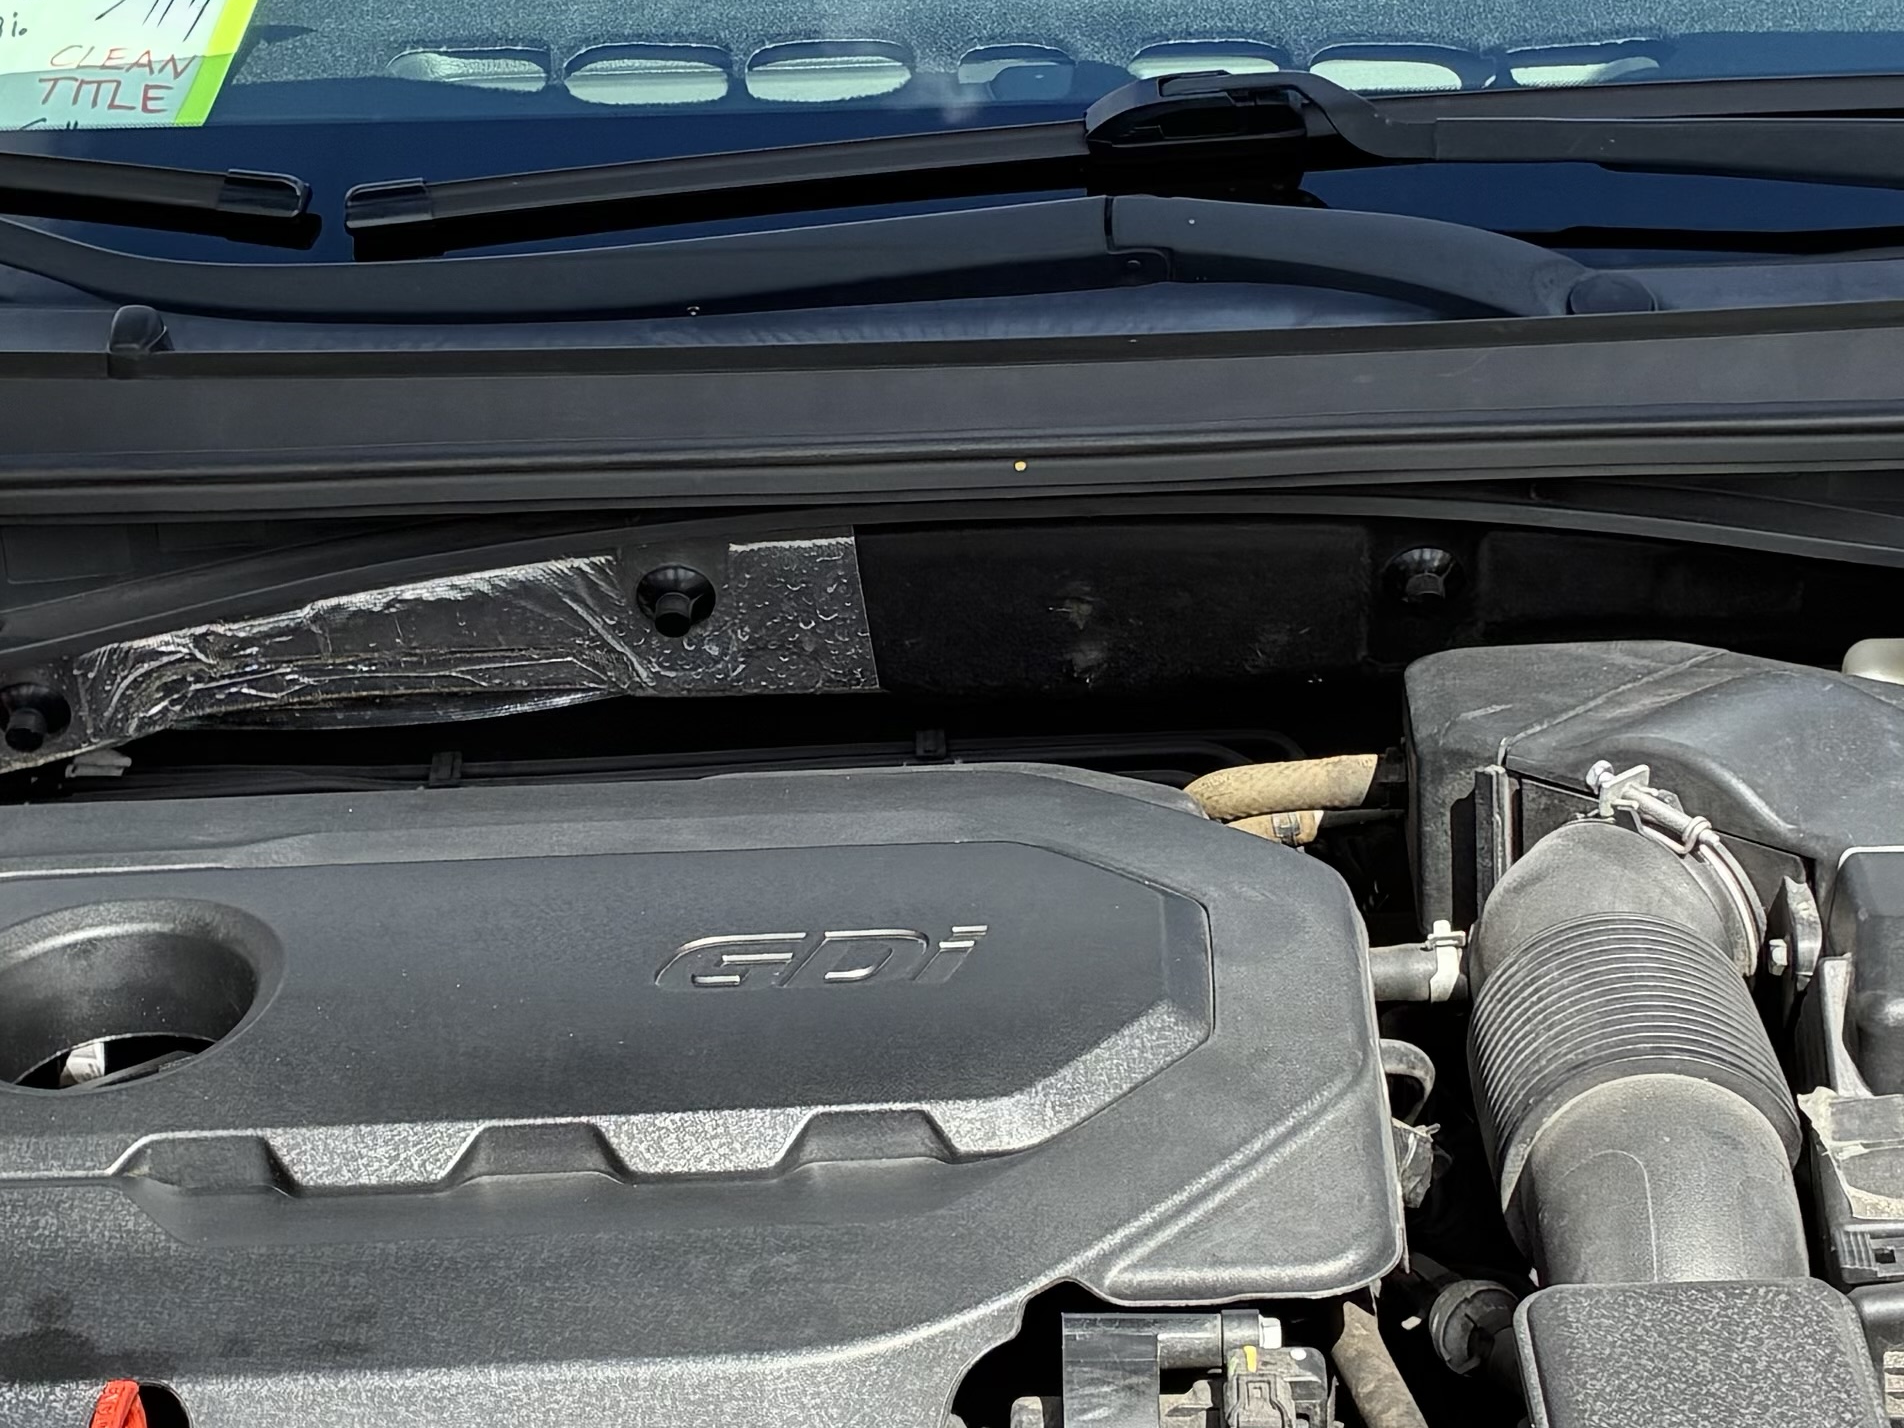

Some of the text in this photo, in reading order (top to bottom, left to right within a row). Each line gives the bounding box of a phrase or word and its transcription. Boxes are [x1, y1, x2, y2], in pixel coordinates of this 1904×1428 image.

[49, 44, 197, 80] CLEAN
[38, 76, 175, 113] TITLE
[654, 924, 989, 988] GDi
